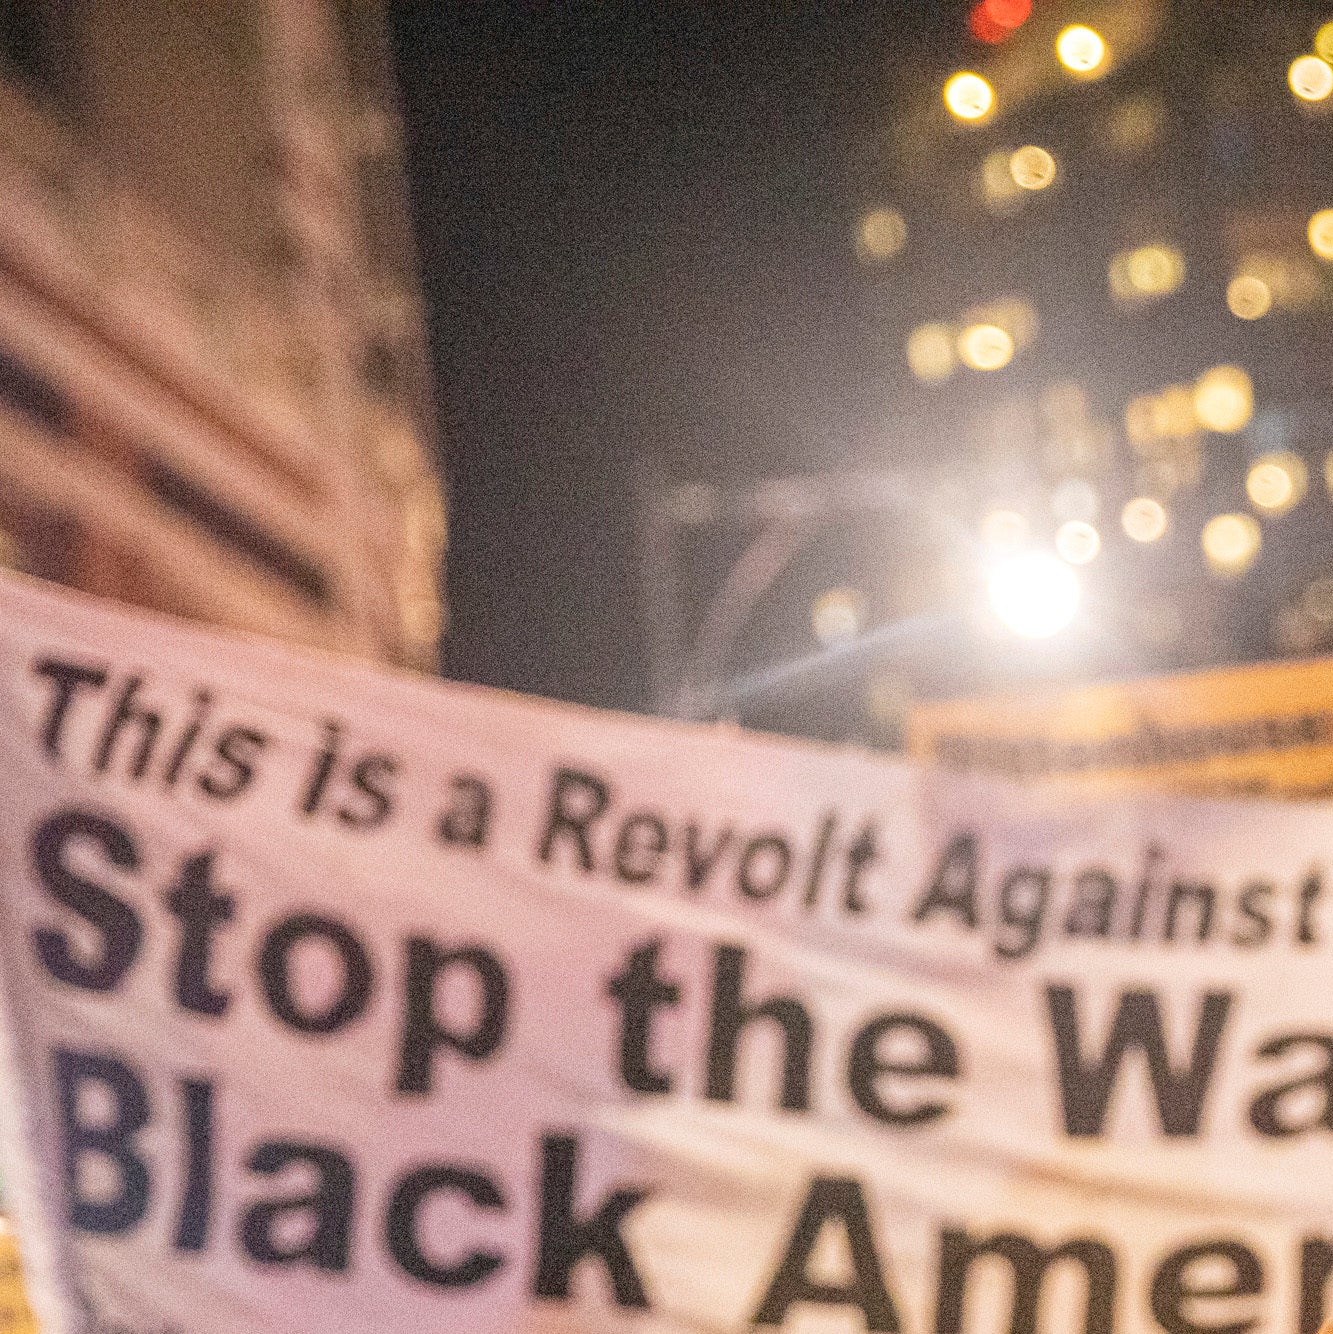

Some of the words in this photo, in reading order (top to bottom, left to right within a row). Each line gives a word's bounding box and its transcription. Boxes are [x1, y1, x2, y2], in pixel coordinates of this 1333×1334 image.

[33, 656, 268, 800] This
[298, 714, 398, 829] is
[438, 774, 493, 849] a
[540, 765, 877, 914] Revolt
[915, 832, 1326, 960] Against
[31, 807, 510, 1097] Stop
[607, 936, 960, 1127] the
[54, 1047, 656, 1310] Black
